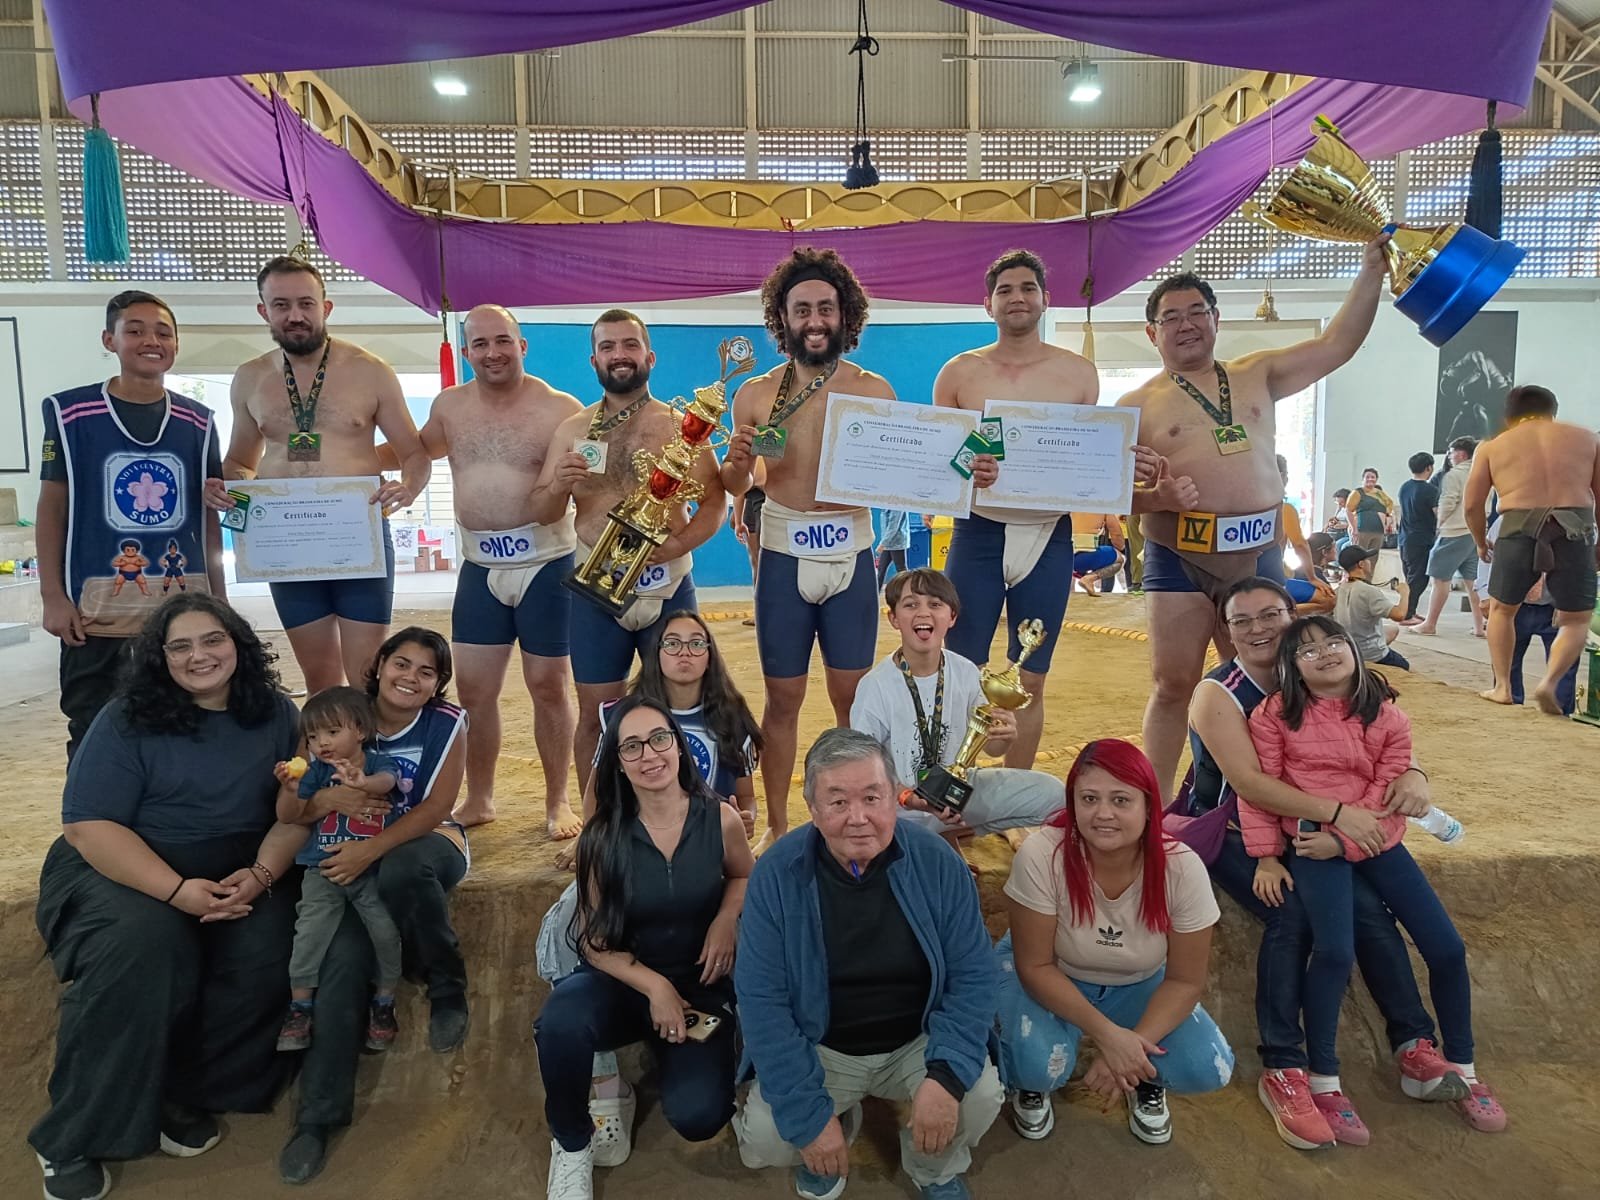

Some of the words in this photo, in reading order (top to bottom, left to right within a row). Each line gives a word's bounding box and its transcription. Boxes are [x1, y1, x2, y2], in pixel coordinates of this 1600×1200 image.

[880, 434, 922, 446] Certificado
[1038, 437, 1080, 447] Certificado
[119, 464, 139, 481] NOVA
[139, 463, 174, 481] CENTRAL
[129, 510, 169, 523] SUMO
[283, 511, 327, 520] Certificado
[808, 524, 835, 549] NC
[1181, 516, 1211, 545] IV
[1240, 518, 1263, 544] NC
[489, 535, 515, 558] NC
[1095, 939, 1123, 948] adidas
